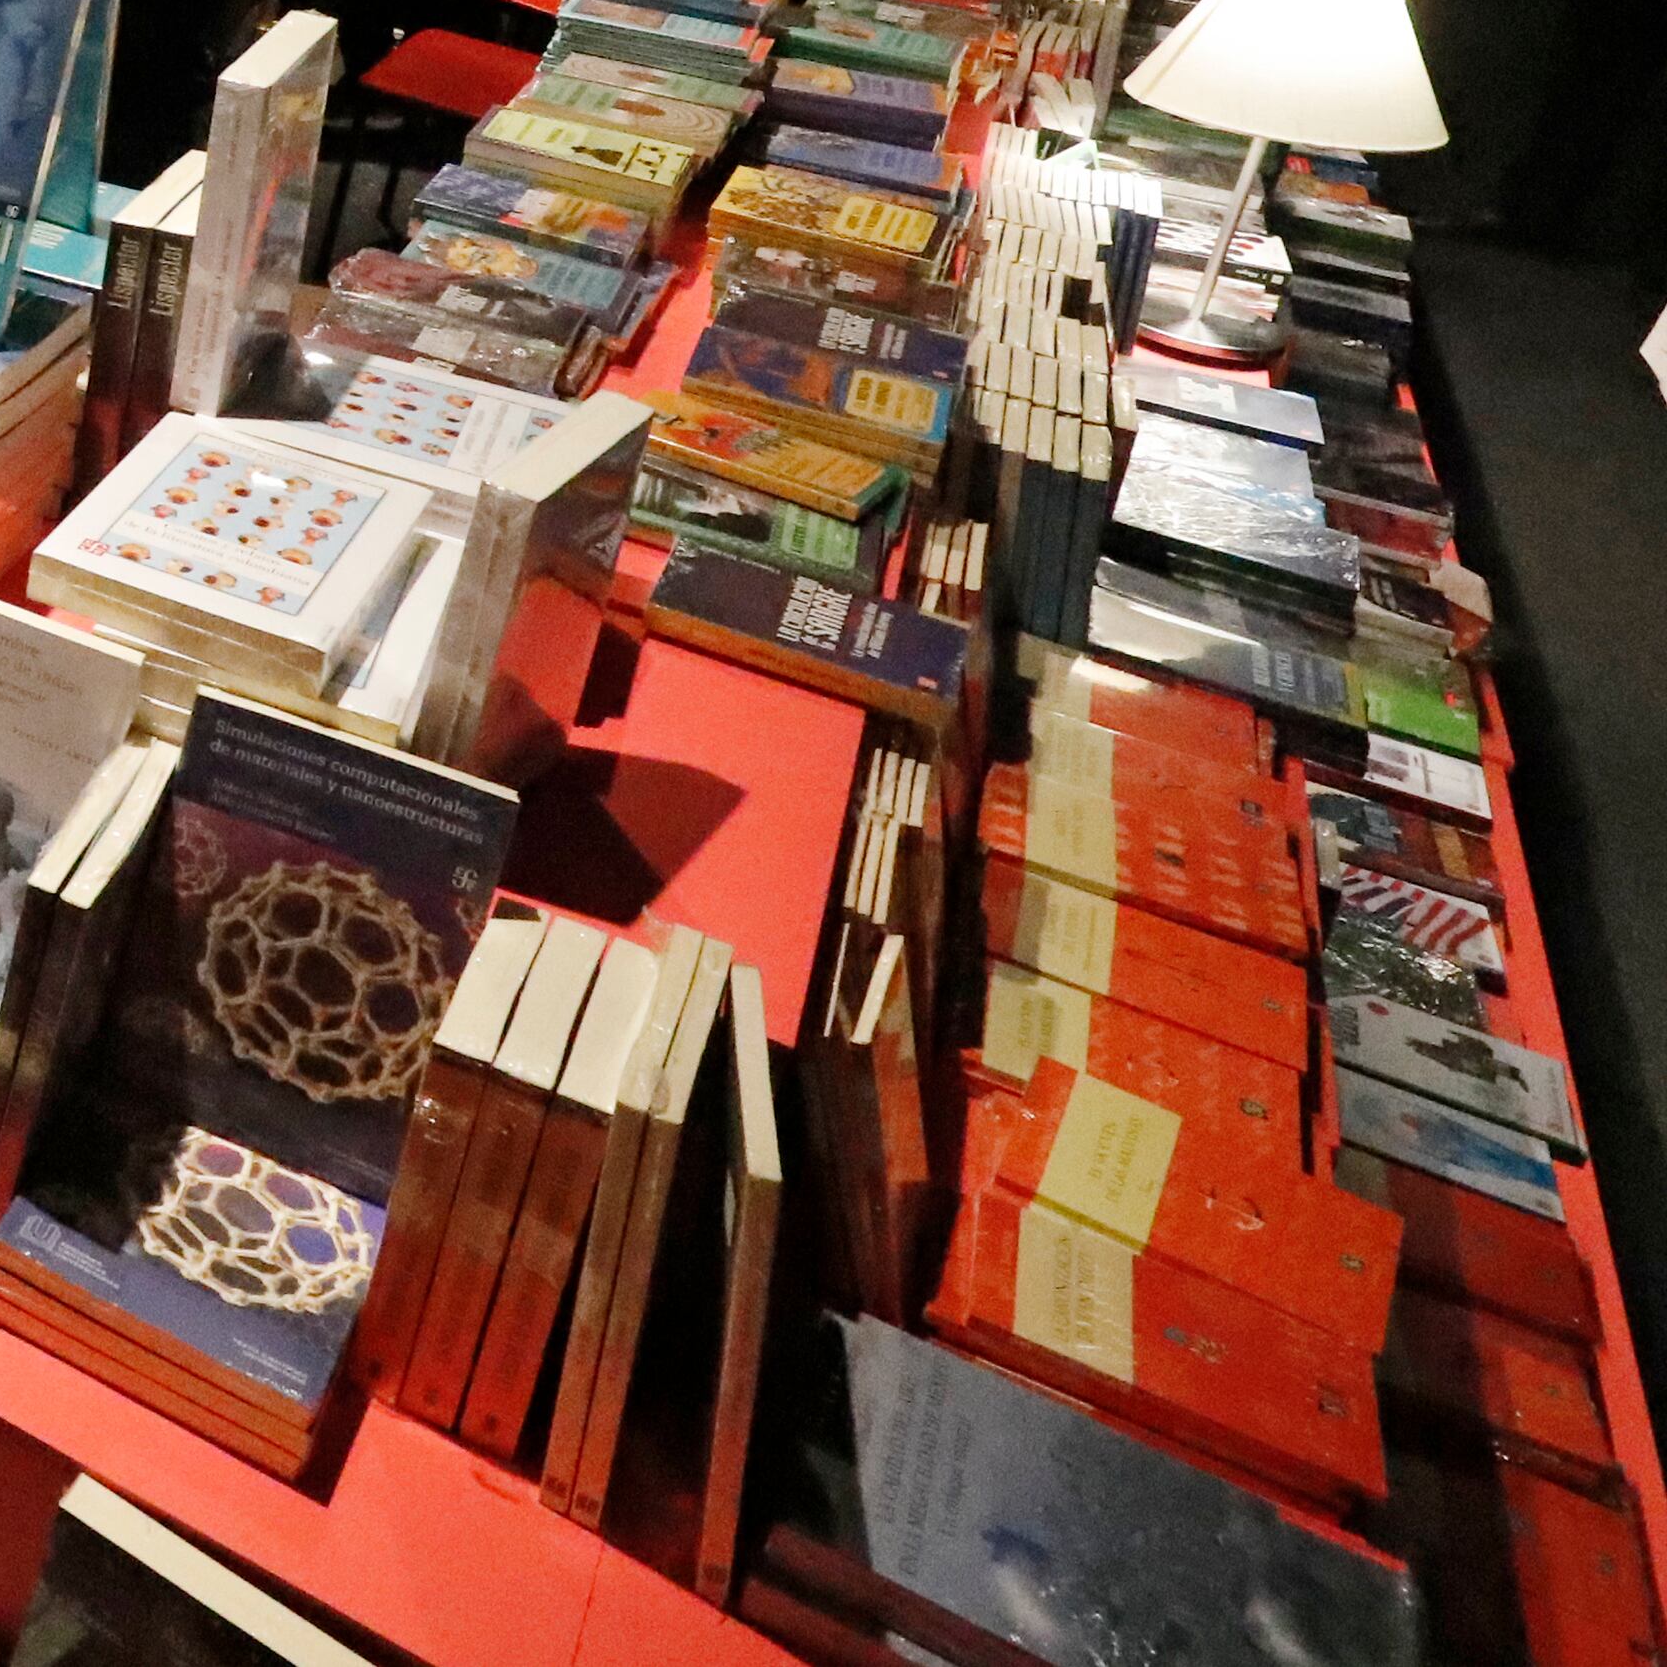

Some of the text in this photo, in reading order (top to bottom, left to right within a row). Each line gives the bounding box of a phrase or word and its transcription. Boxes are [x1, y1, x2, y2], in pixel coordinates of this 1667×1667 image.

[106, 235, 142, 310] Lispector
[147, 242, 184, 318] Lispector
[804, 584, 854, 644] SANGRE
[13, 658, 33, 673] de
[208, 737, 230, 755] de
[233, 746, 325, 789] materiales
[325, 777, 339, 795] y
[340, 783, 486, 846] nanoestructuras
[214, 717, 328, 768] Simulaciones
[329, 759, 480, 823] computacionales
